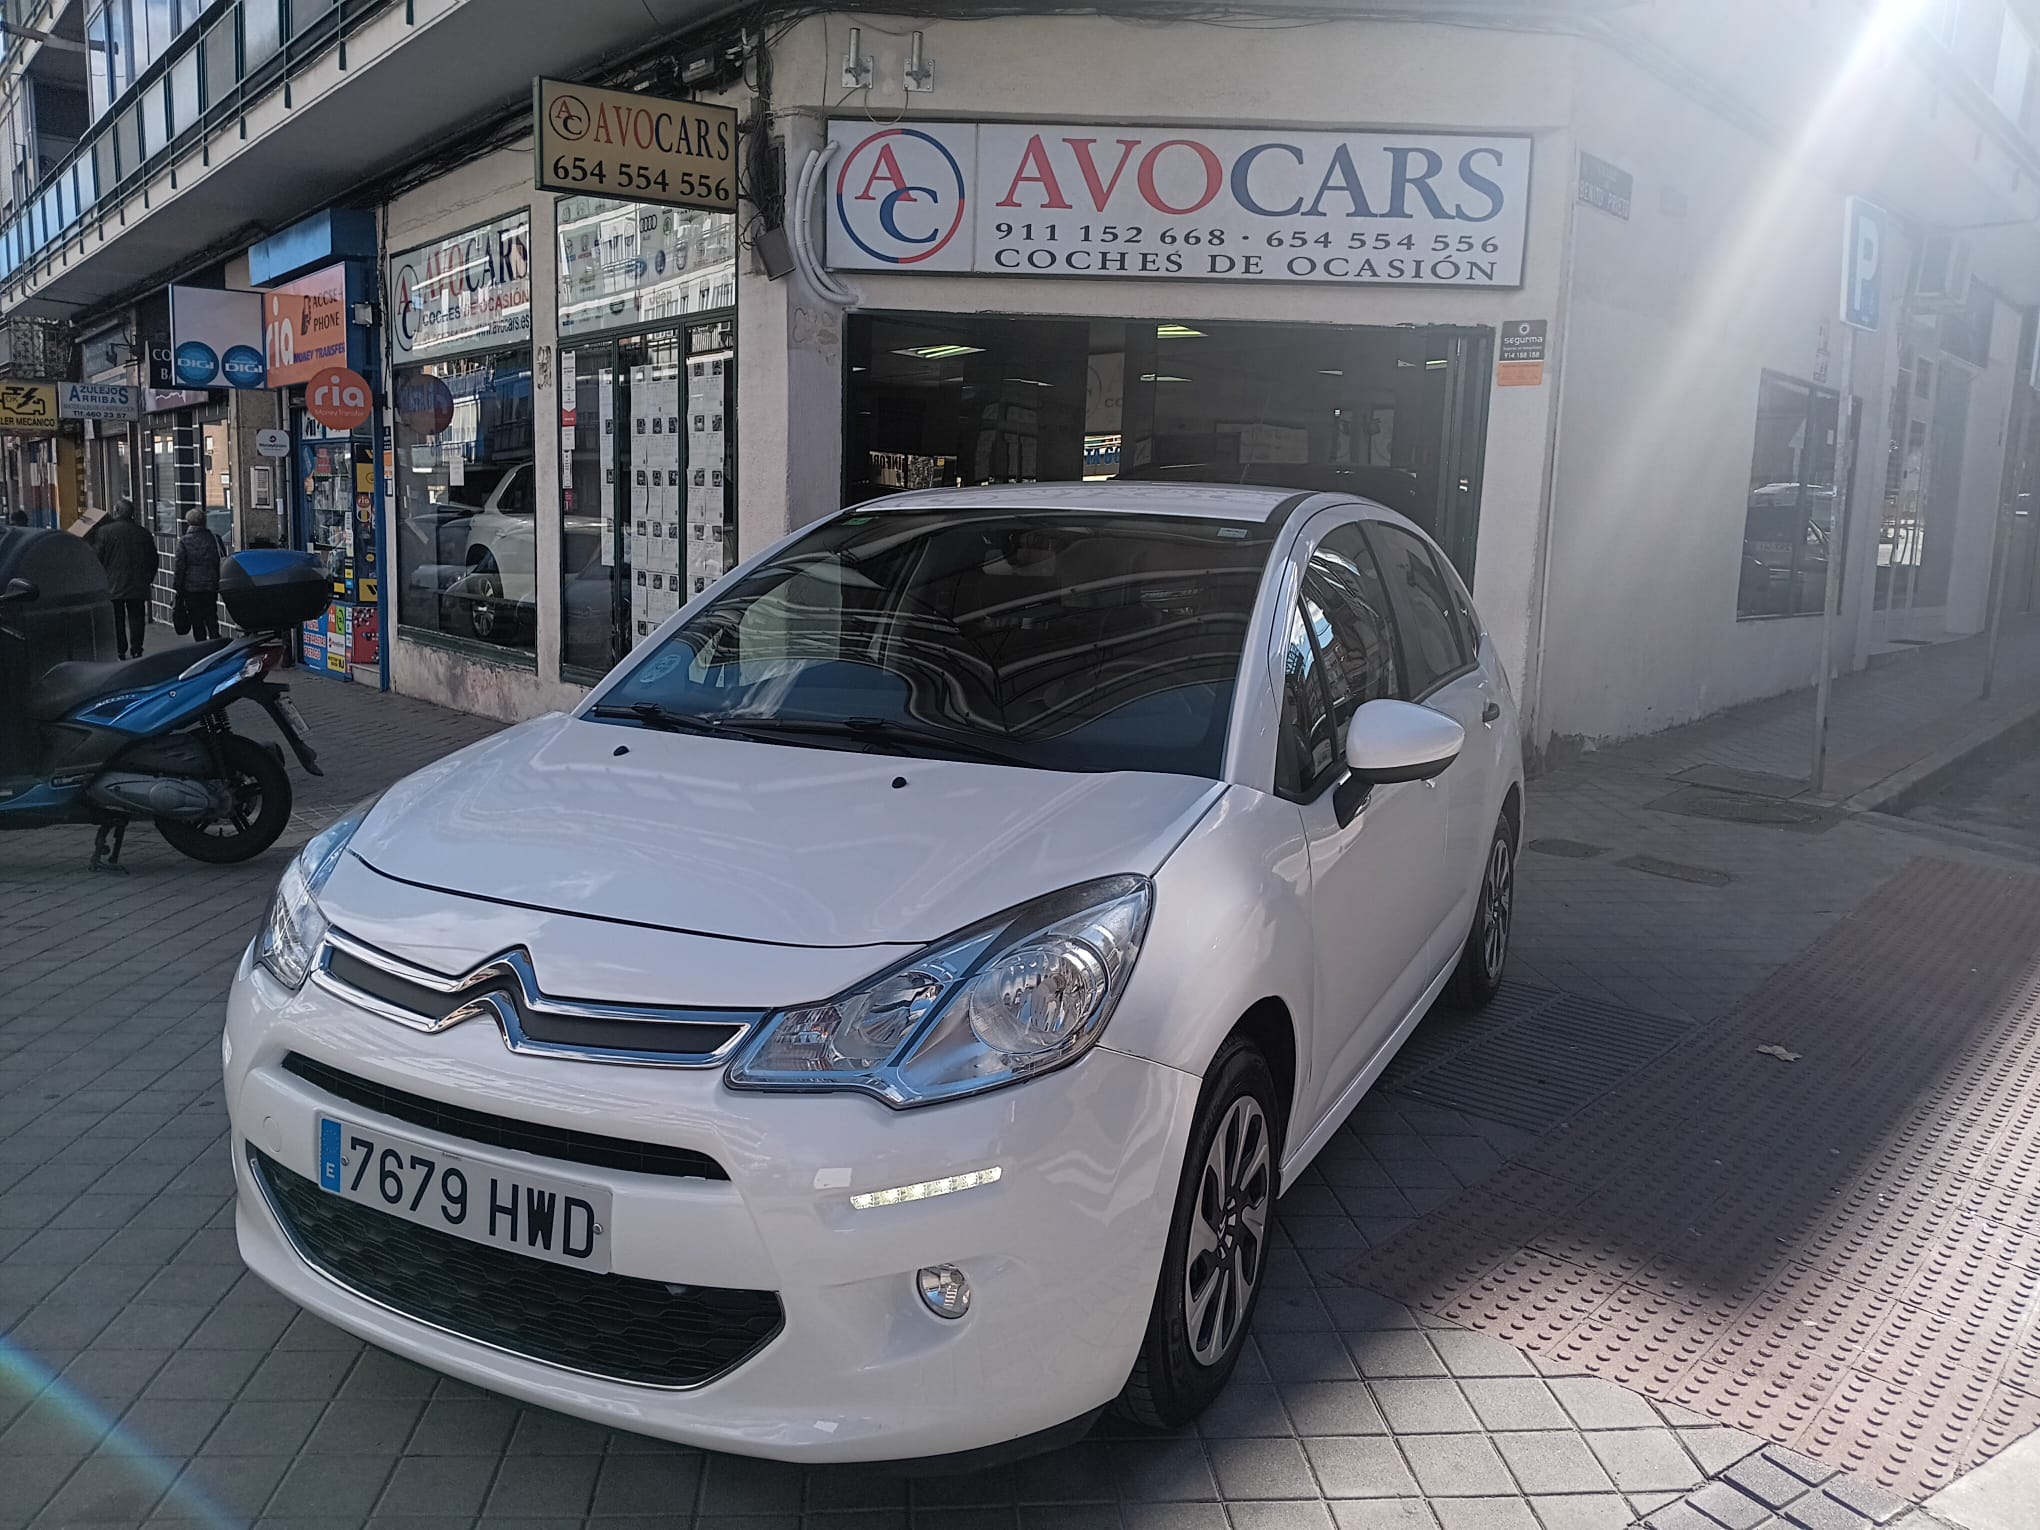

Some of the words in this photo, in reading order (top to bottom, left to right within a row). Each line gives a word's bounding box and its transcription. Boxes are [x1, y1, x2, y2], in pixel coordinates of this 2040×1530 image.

[593, 101, 730, 161] AVOCARS
[553, 154, 607, 185] 654
[617, 162, 669, 193] 554
[679, 171, 730, 201] 556
[995, 133, 1505, 223] AVOCARS
[995, 222, 1059, 242] 911
[1080, 224, 1143, 244] 152
[1159, 227, 1226, 247] 668
[1266, 230, 1333, 249] 654
[1347, 232, 1416, 251] 554
[1431, 234, 1499, 254] 556
[423, 222, 528, 304] AVOCARS
[994, 247, 1183, 273] COCHES
[1206, 253, 1264, 276] DE
[1286, 254, 1498, 282] OCASIÓN
[1853, 214, 1879, 311] P
[313, 311, 340, 333] PHONE
[423, 305, 461, 327] COCHES
[480, 288, 529, 313] OCASIÓN
[265, 294, 295, 371] ria
[1503, 336, 1543, 345] segurma
[177, 358, 215, 370] DIGI
[224, 362, 263, 373] DIGI
[314, 374, 365, 408] ria
[325, 1163, 336, 1179] E
[350, 1135, 468, 1225] 7679
[489, 1177, 596, 1260] HWD
